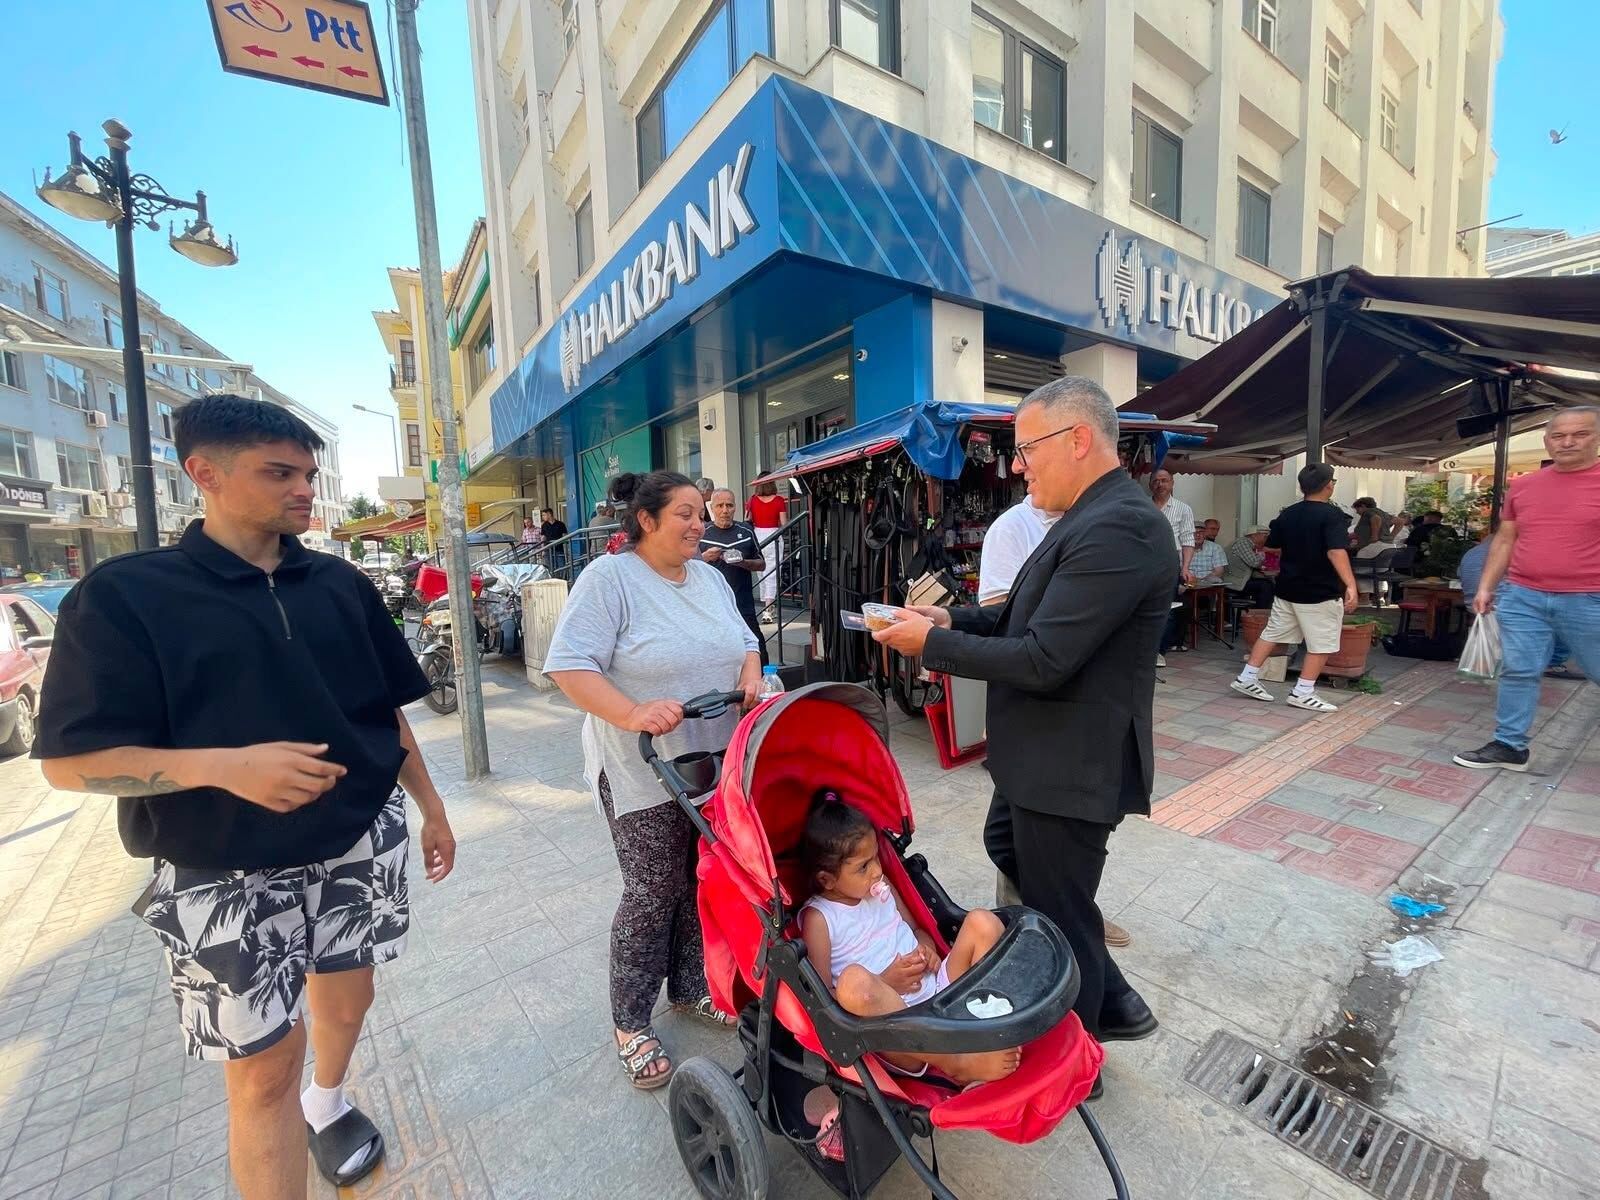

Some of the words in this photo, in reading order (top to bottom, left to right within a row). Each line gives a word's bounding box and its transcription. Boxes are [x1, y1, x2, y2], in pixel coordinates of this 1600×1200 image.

[305, 8, 364, 53] Ptt
[580, 142, 756, 365] HALKBANK
[10, 487, 44, 502] DÖNER
